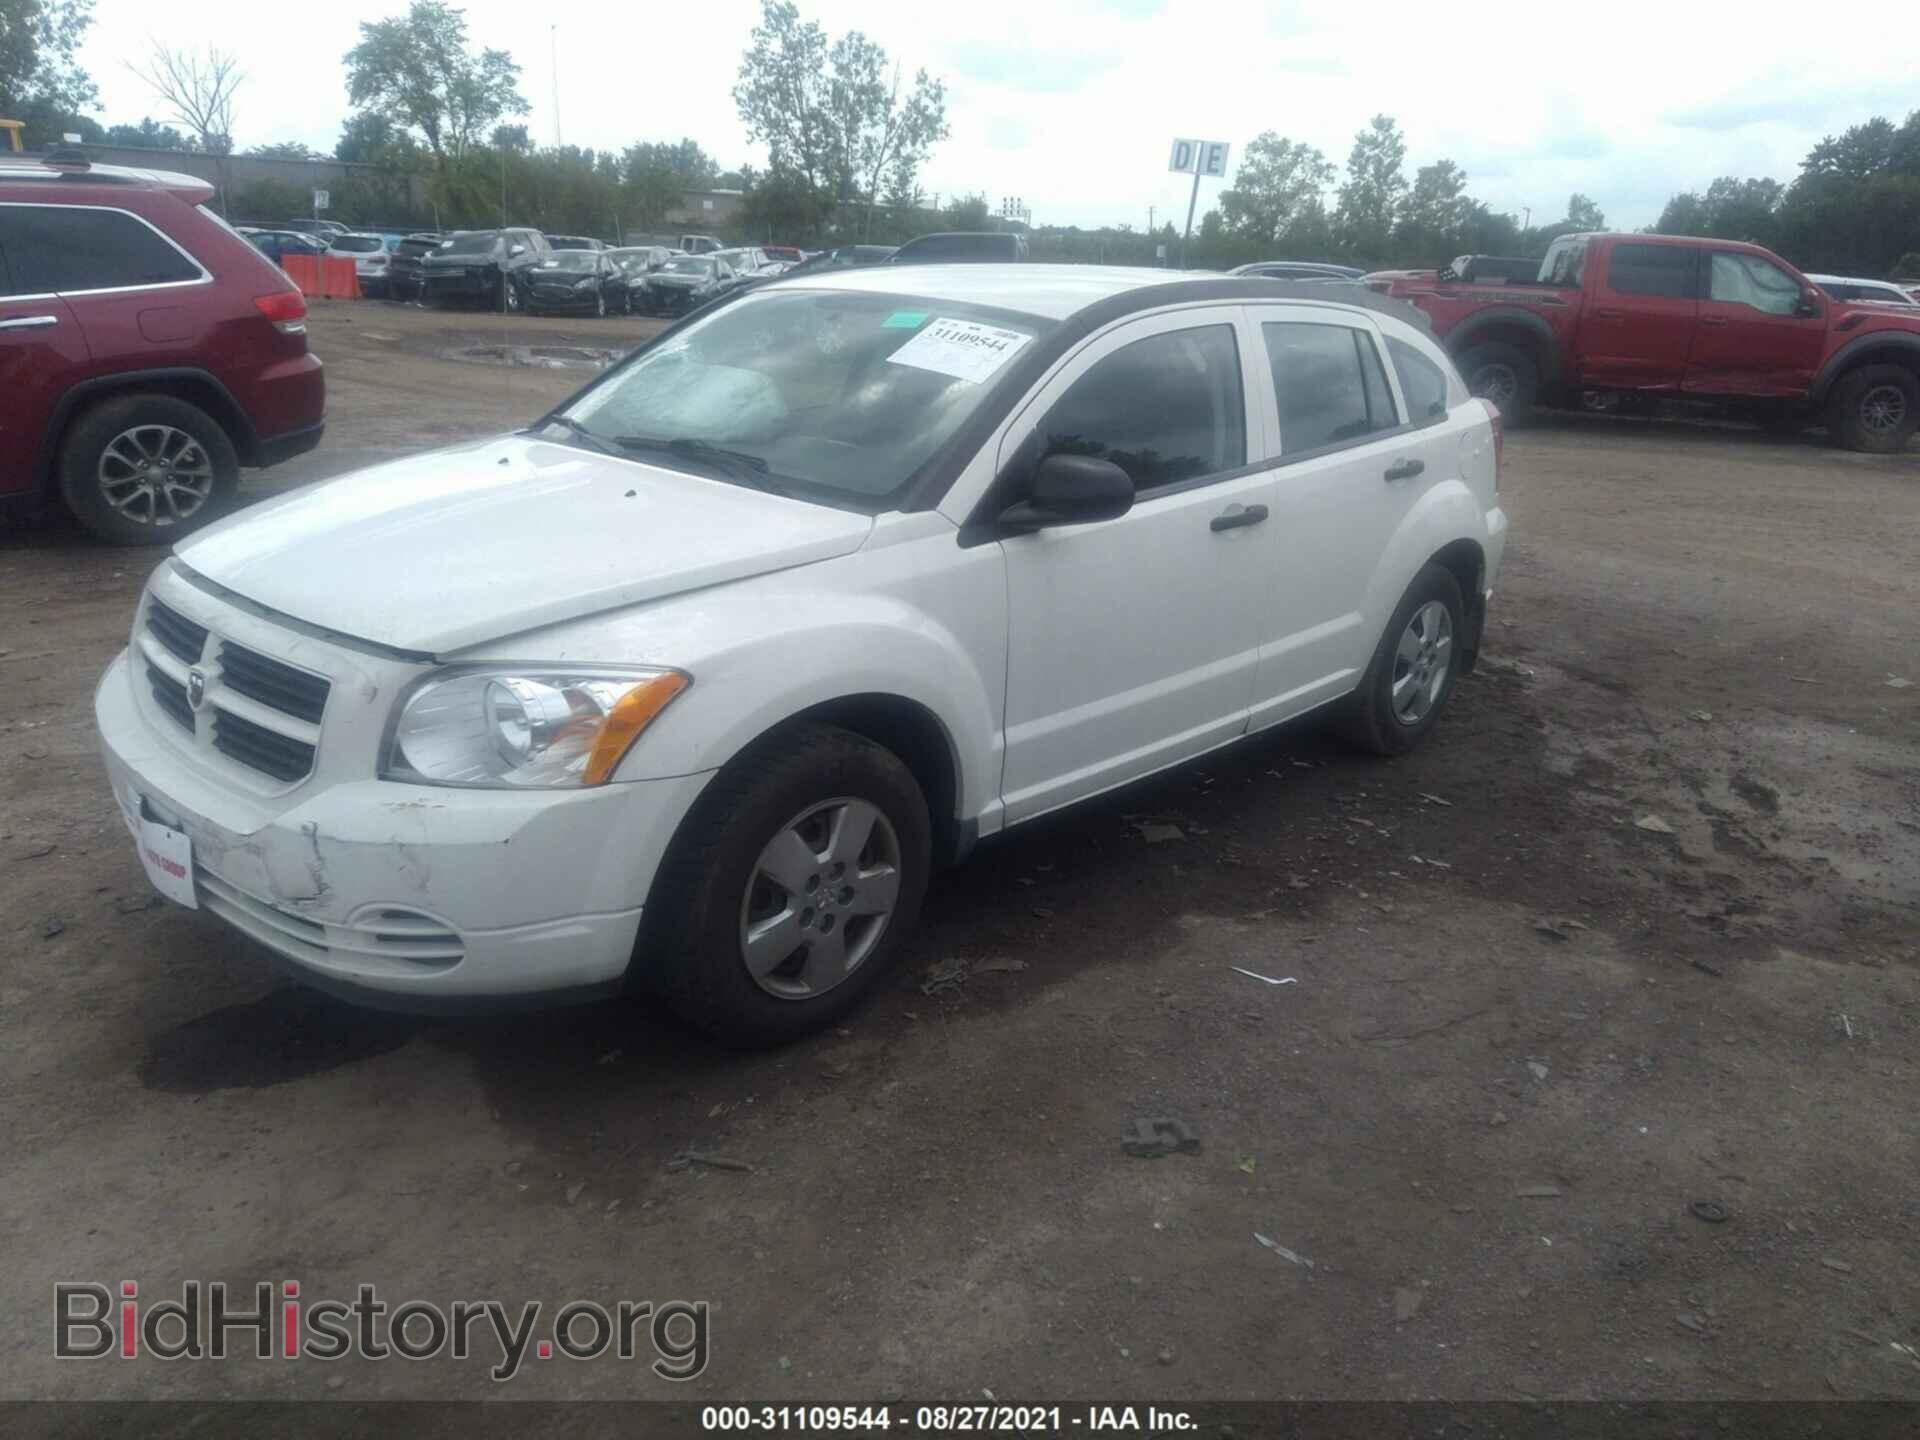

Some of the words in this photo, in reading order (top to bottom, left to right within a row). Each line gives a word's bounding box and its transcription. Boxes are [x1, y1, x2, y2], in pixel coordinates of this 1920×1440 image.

[1174, 141, 1191, 170] D
[1206, 144, 1223, 174] E
[929, 327, 1009, 351] 31109544
